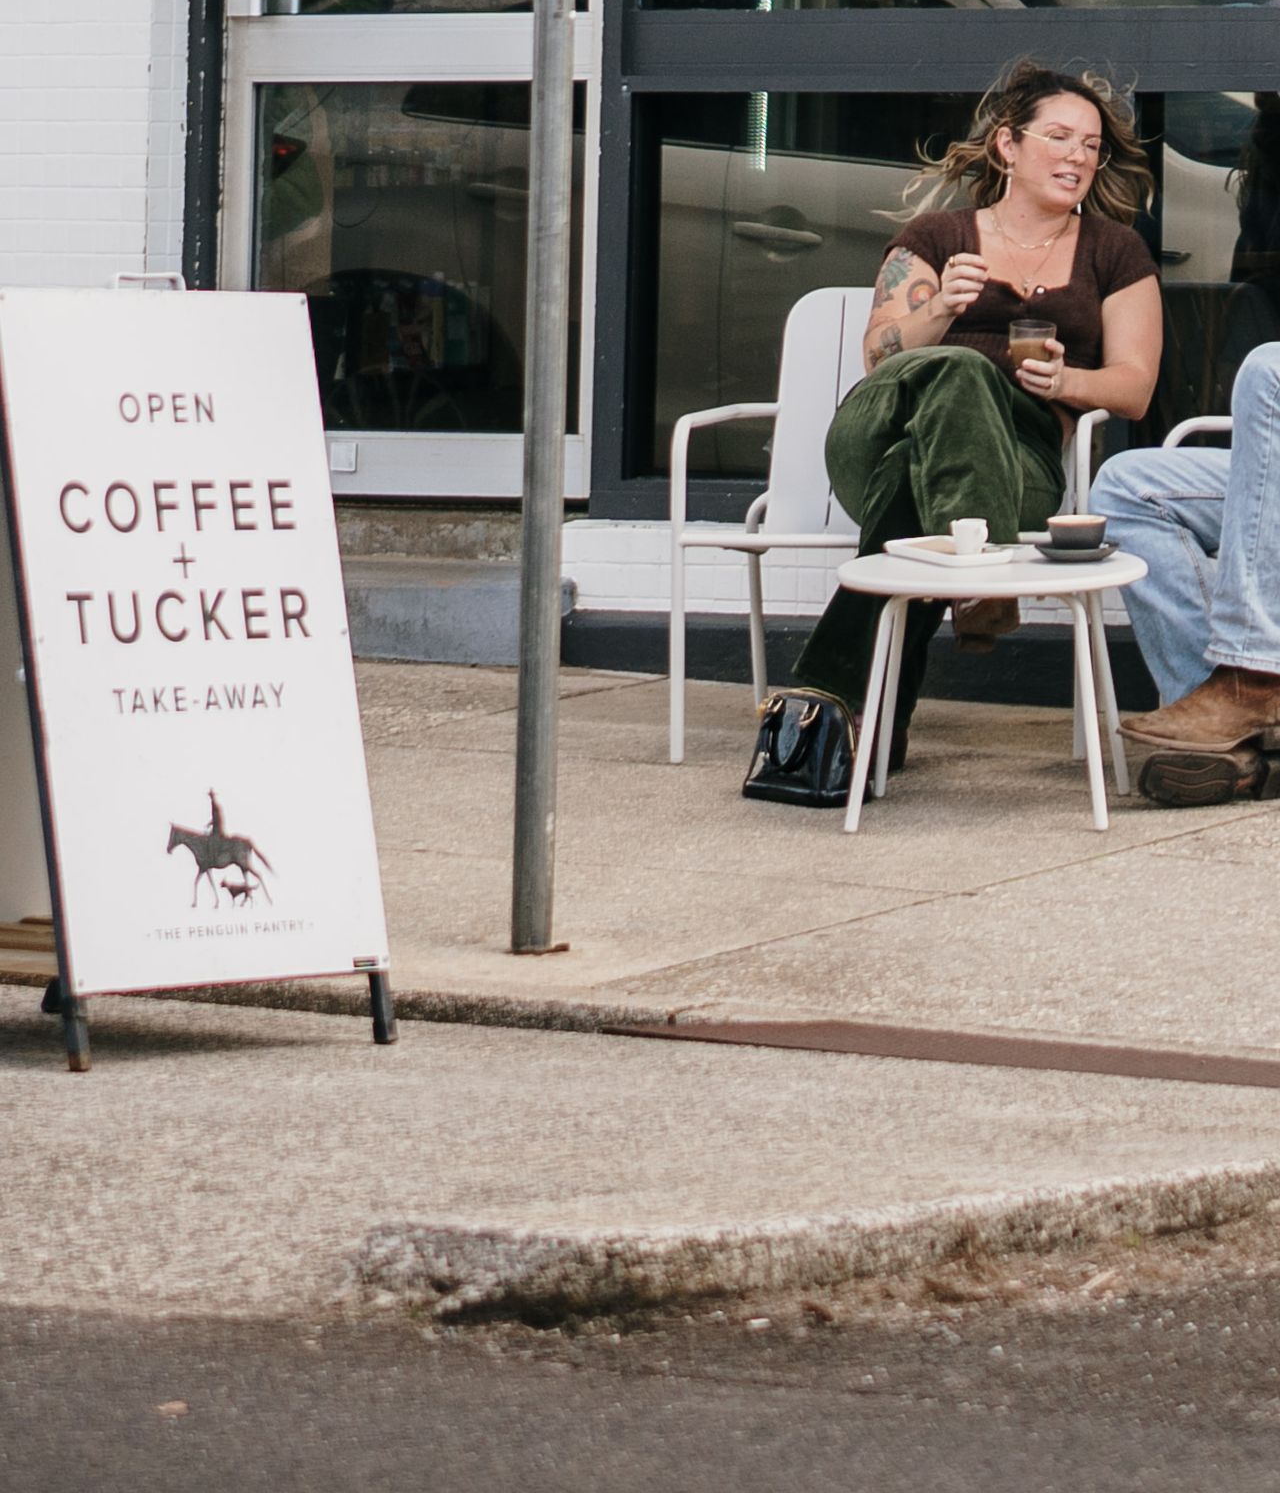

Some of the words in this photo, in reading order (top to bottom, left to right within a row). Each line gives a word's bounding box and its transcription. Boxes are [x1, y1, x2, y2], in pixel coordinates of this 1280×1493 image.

[119, 392, 216, 424] OPEN
[59, 478, 298, 534] COFFEE
[172, 542, 197, 579] +
[67, 586, 312, 646] TUCKER
[112, 681, 286, 715] TAKE-AWAY
[155, 927, 182, 940] THE
[188, 924, 249, 939] PENGUIN
[254, 919, 305, 933] PANTRY
